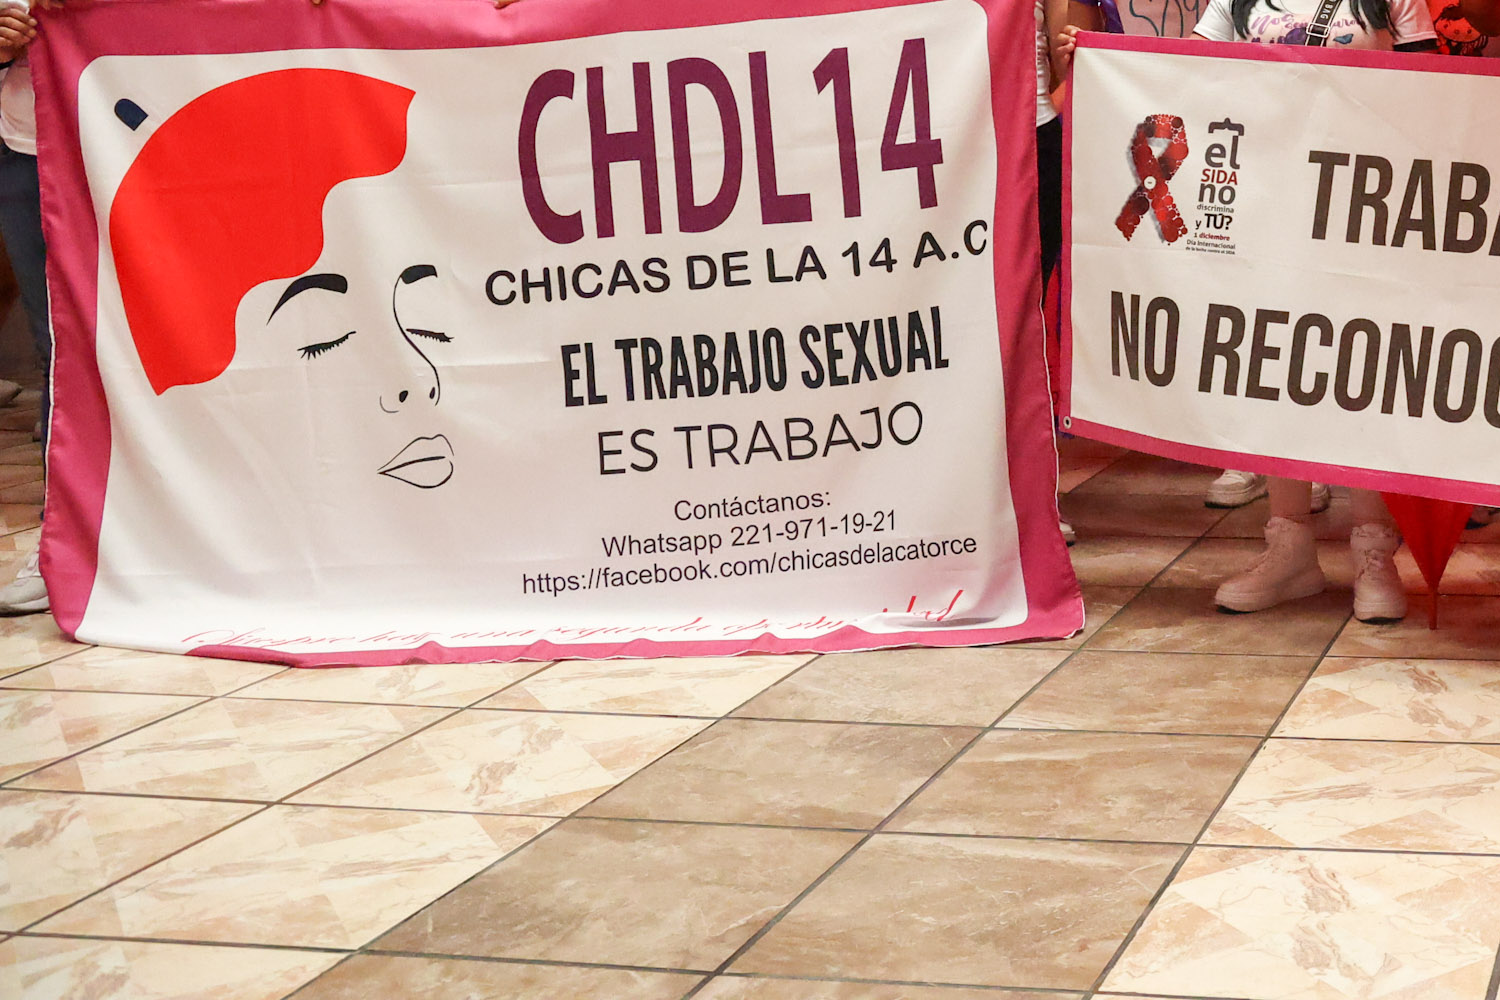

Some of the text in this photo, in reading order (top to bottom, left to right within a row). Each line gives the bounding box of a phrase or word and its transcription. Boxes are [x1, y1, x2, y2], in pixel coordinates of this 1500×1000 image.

[1320, 4, 1333, 19] BAG
[518, 37, 944, 244] CHDL14
[1205, 135, 1240, 170] el
[1201, 168, 1238, 185] SIDA
[1196, 203, 1235, 214] discrimina
[1198, 183, 1236, 205] no
[1195, 213, 1233, 230] y TÚ?
[1199, 232, 1230, 241] diciembre
[1197, 240, 1236, 250] Internacional
[485, 219, 988, 306] CHICAS DE LA 14 A.C
[1111, 290, 1181, 387] NO
[561, 306, 949, 407] EL TRABAJO SEXUAL
[598, 401, 923, 476] ES TRABAJO
[674, 492, 831, 522] Contáctanos:
[602, 508, 896, 558] Whatsapp 221-971-19-21
[523, 534, 978, 597] https://facebook.com/chicasdelacatorce
